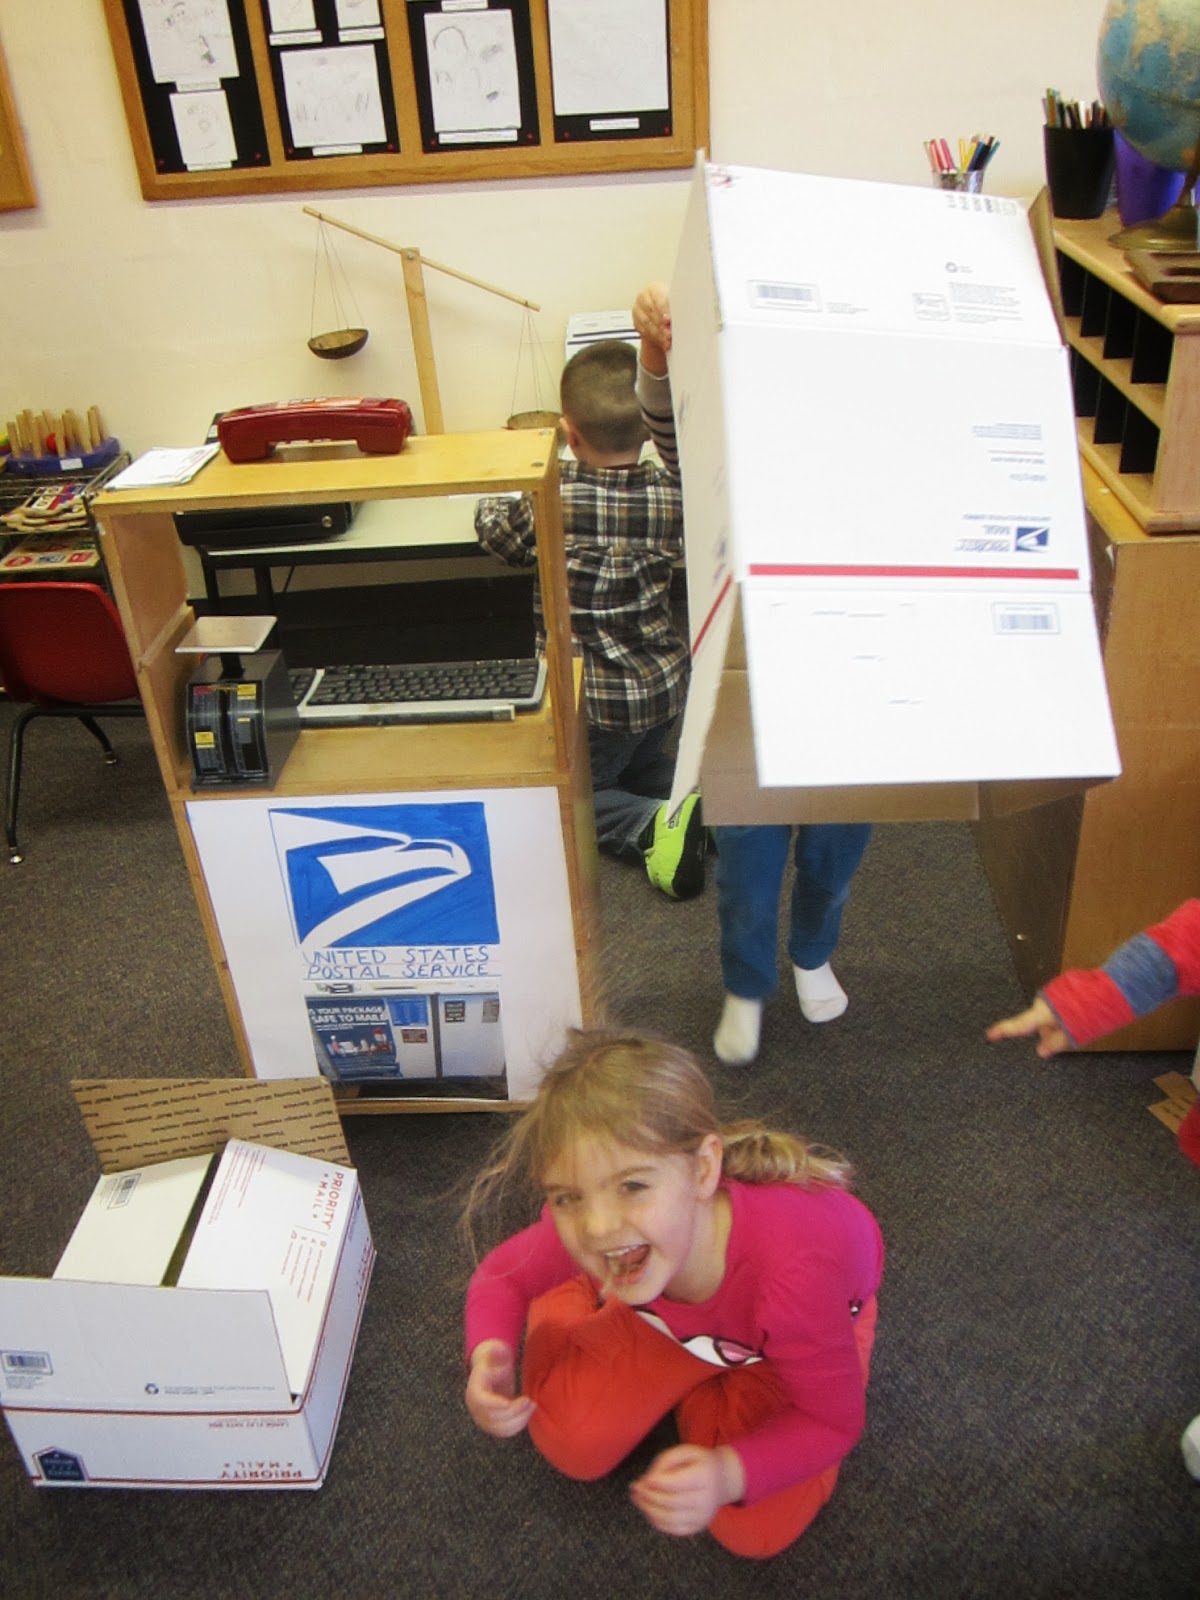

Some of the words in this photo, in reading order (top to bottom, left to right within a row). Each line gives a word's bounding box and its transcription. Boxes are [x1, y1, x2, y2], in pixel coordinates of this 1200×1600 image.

[303, 950, 387, 965] UNITED
[402, 946, 490, 964] STATES
[307, 965, 390, 979] POSTAL
[401, 963, 489, 978] SERVICE
[338, 1014, 354, 1022] TO
[312, 1180, 328, 1209] MAIL
[321, 1171, 344, 1230] PRIORITY
[237, 1460, 280, 1468] MAIL
[220, 1470, 302, 1479] PRIORITY
